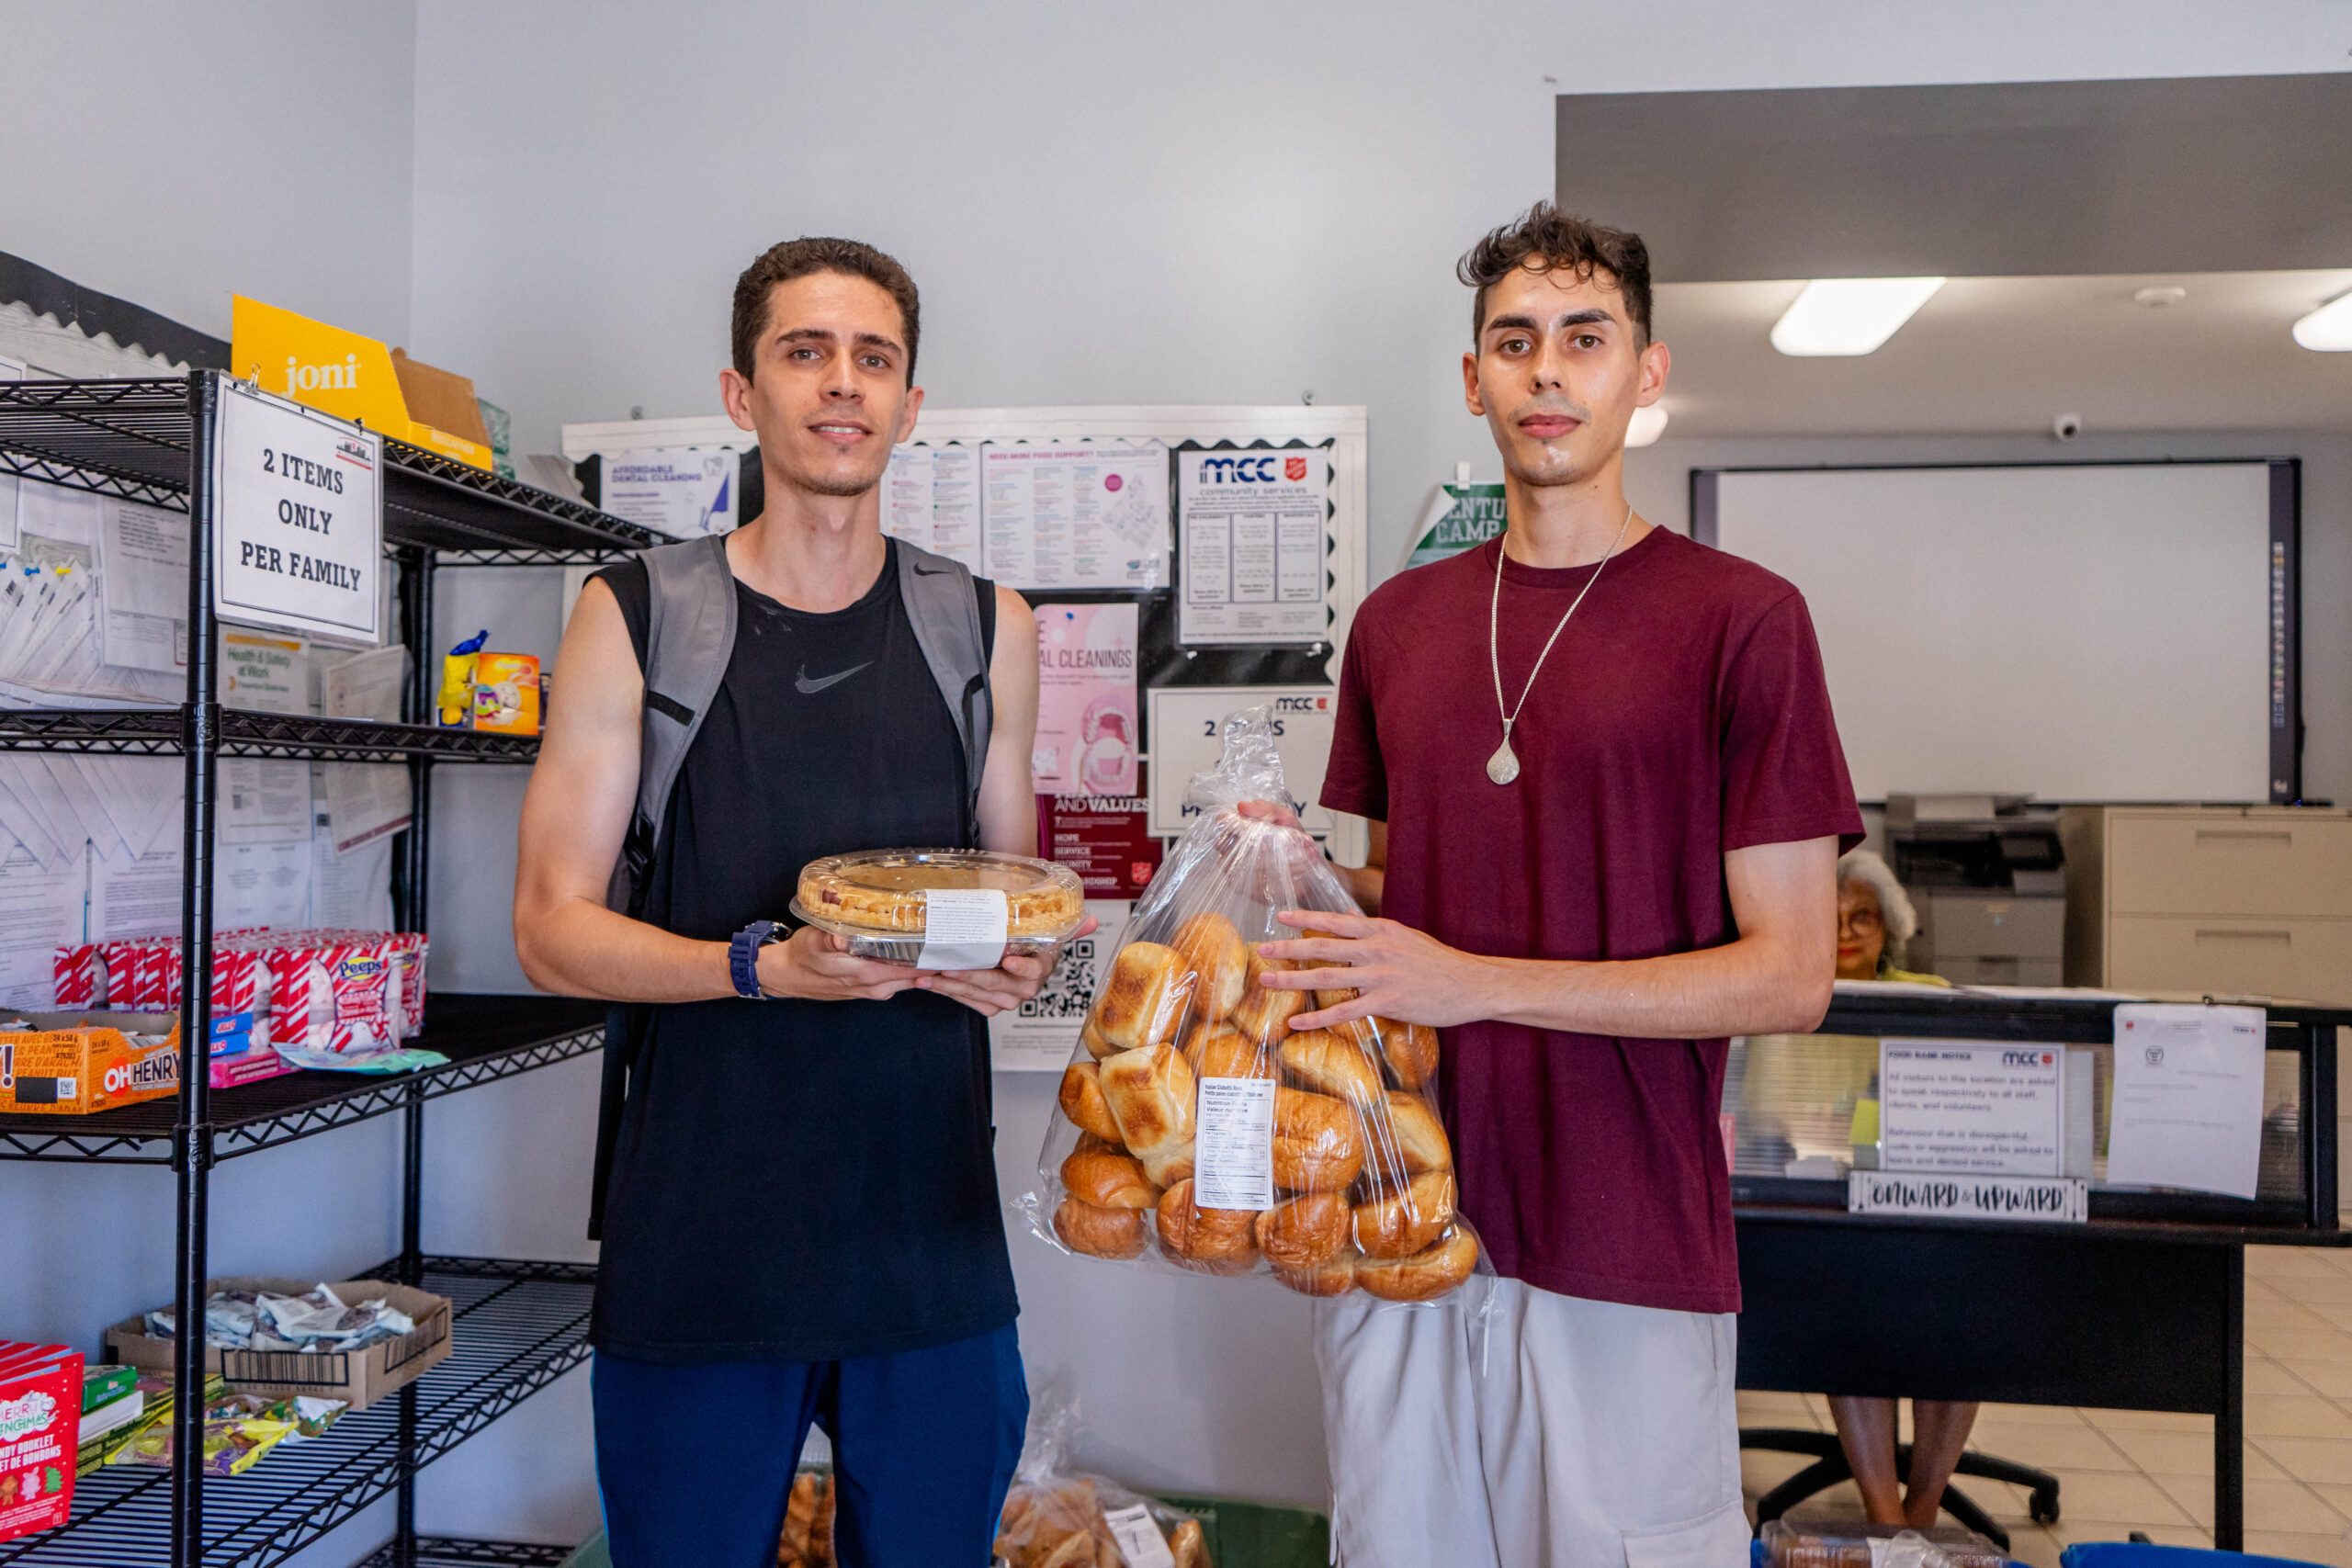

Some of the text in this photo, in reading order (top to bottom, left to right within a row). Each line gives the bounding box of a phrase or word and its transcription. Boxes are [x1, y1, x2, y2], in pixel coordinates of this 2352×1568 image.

[281, 353, 357, 398] joni
[263, 448, 344, 494] 2 ITEMS
[612, 465, 673, 473] AFFORDABLE
[612, 472, 702, 482] DENTAL CLEANING
[1199, 487, 1307, 497] community services
[278, 499, 332, 536] ONLY
[1448, 497, 1507, 520] ENTU
[1435, 520, 1500, 544] CAMP
[241, 540, 361, 592] PER FAMILY
[1059, 649, 1132, 669] CLEANINGS
[1204, 720, 1216, 736] 2
[1054, 797, 1148, 813] AND VALUES
[338, 961, 382, 976] Peeps
[1941, 1052, 1972, 1061] NOTICE
[104, 1053, 180, 1092] OH HENRY
[1872, 1181, 1959, 1209] ONWARD
[1975, 1184, 2063, 1213] UPWARD
[0, 1403, 37, 1420] ERRY
[0, 1434, 54, 1460] NDY BOOKLET
[10, 1455, 22, 1470] DE
[23, 1445, 62, 1466] BONBONS
